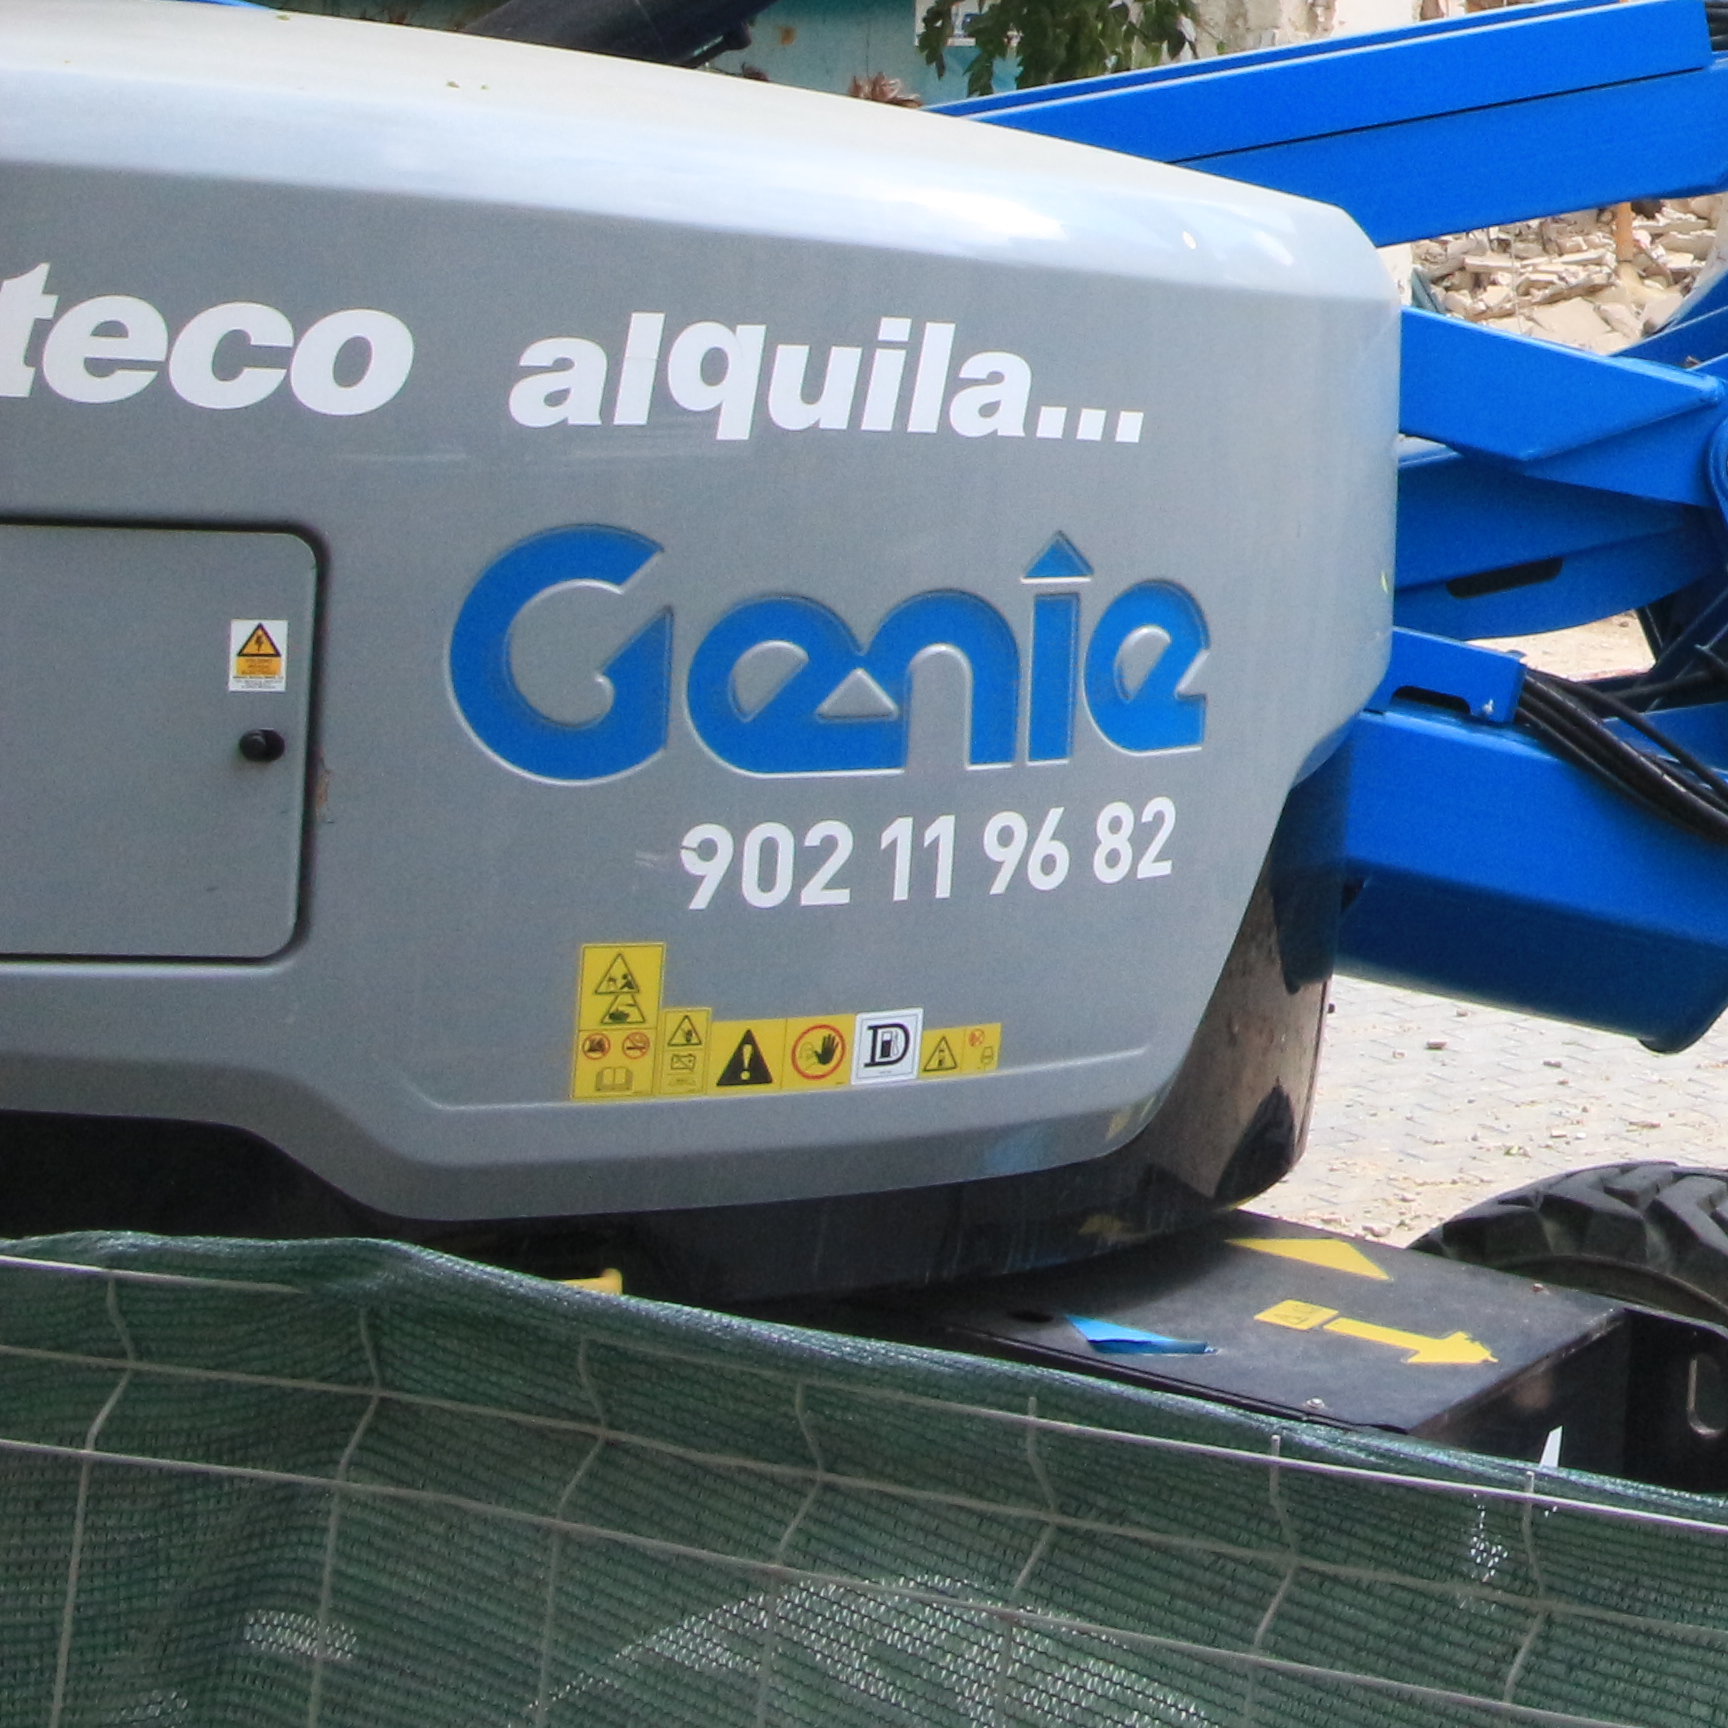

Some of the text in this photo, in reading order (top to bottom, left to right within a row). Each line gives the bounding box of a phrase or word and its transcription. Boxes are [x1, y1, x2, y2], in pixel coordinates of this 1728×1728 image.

[507, 311, 1148, 444] alquila...
[446, 524, 1212, 785] Genie
[679, 794, 1178, 911] 902 11 96 82
[863, 1022, 911, 1068] D
